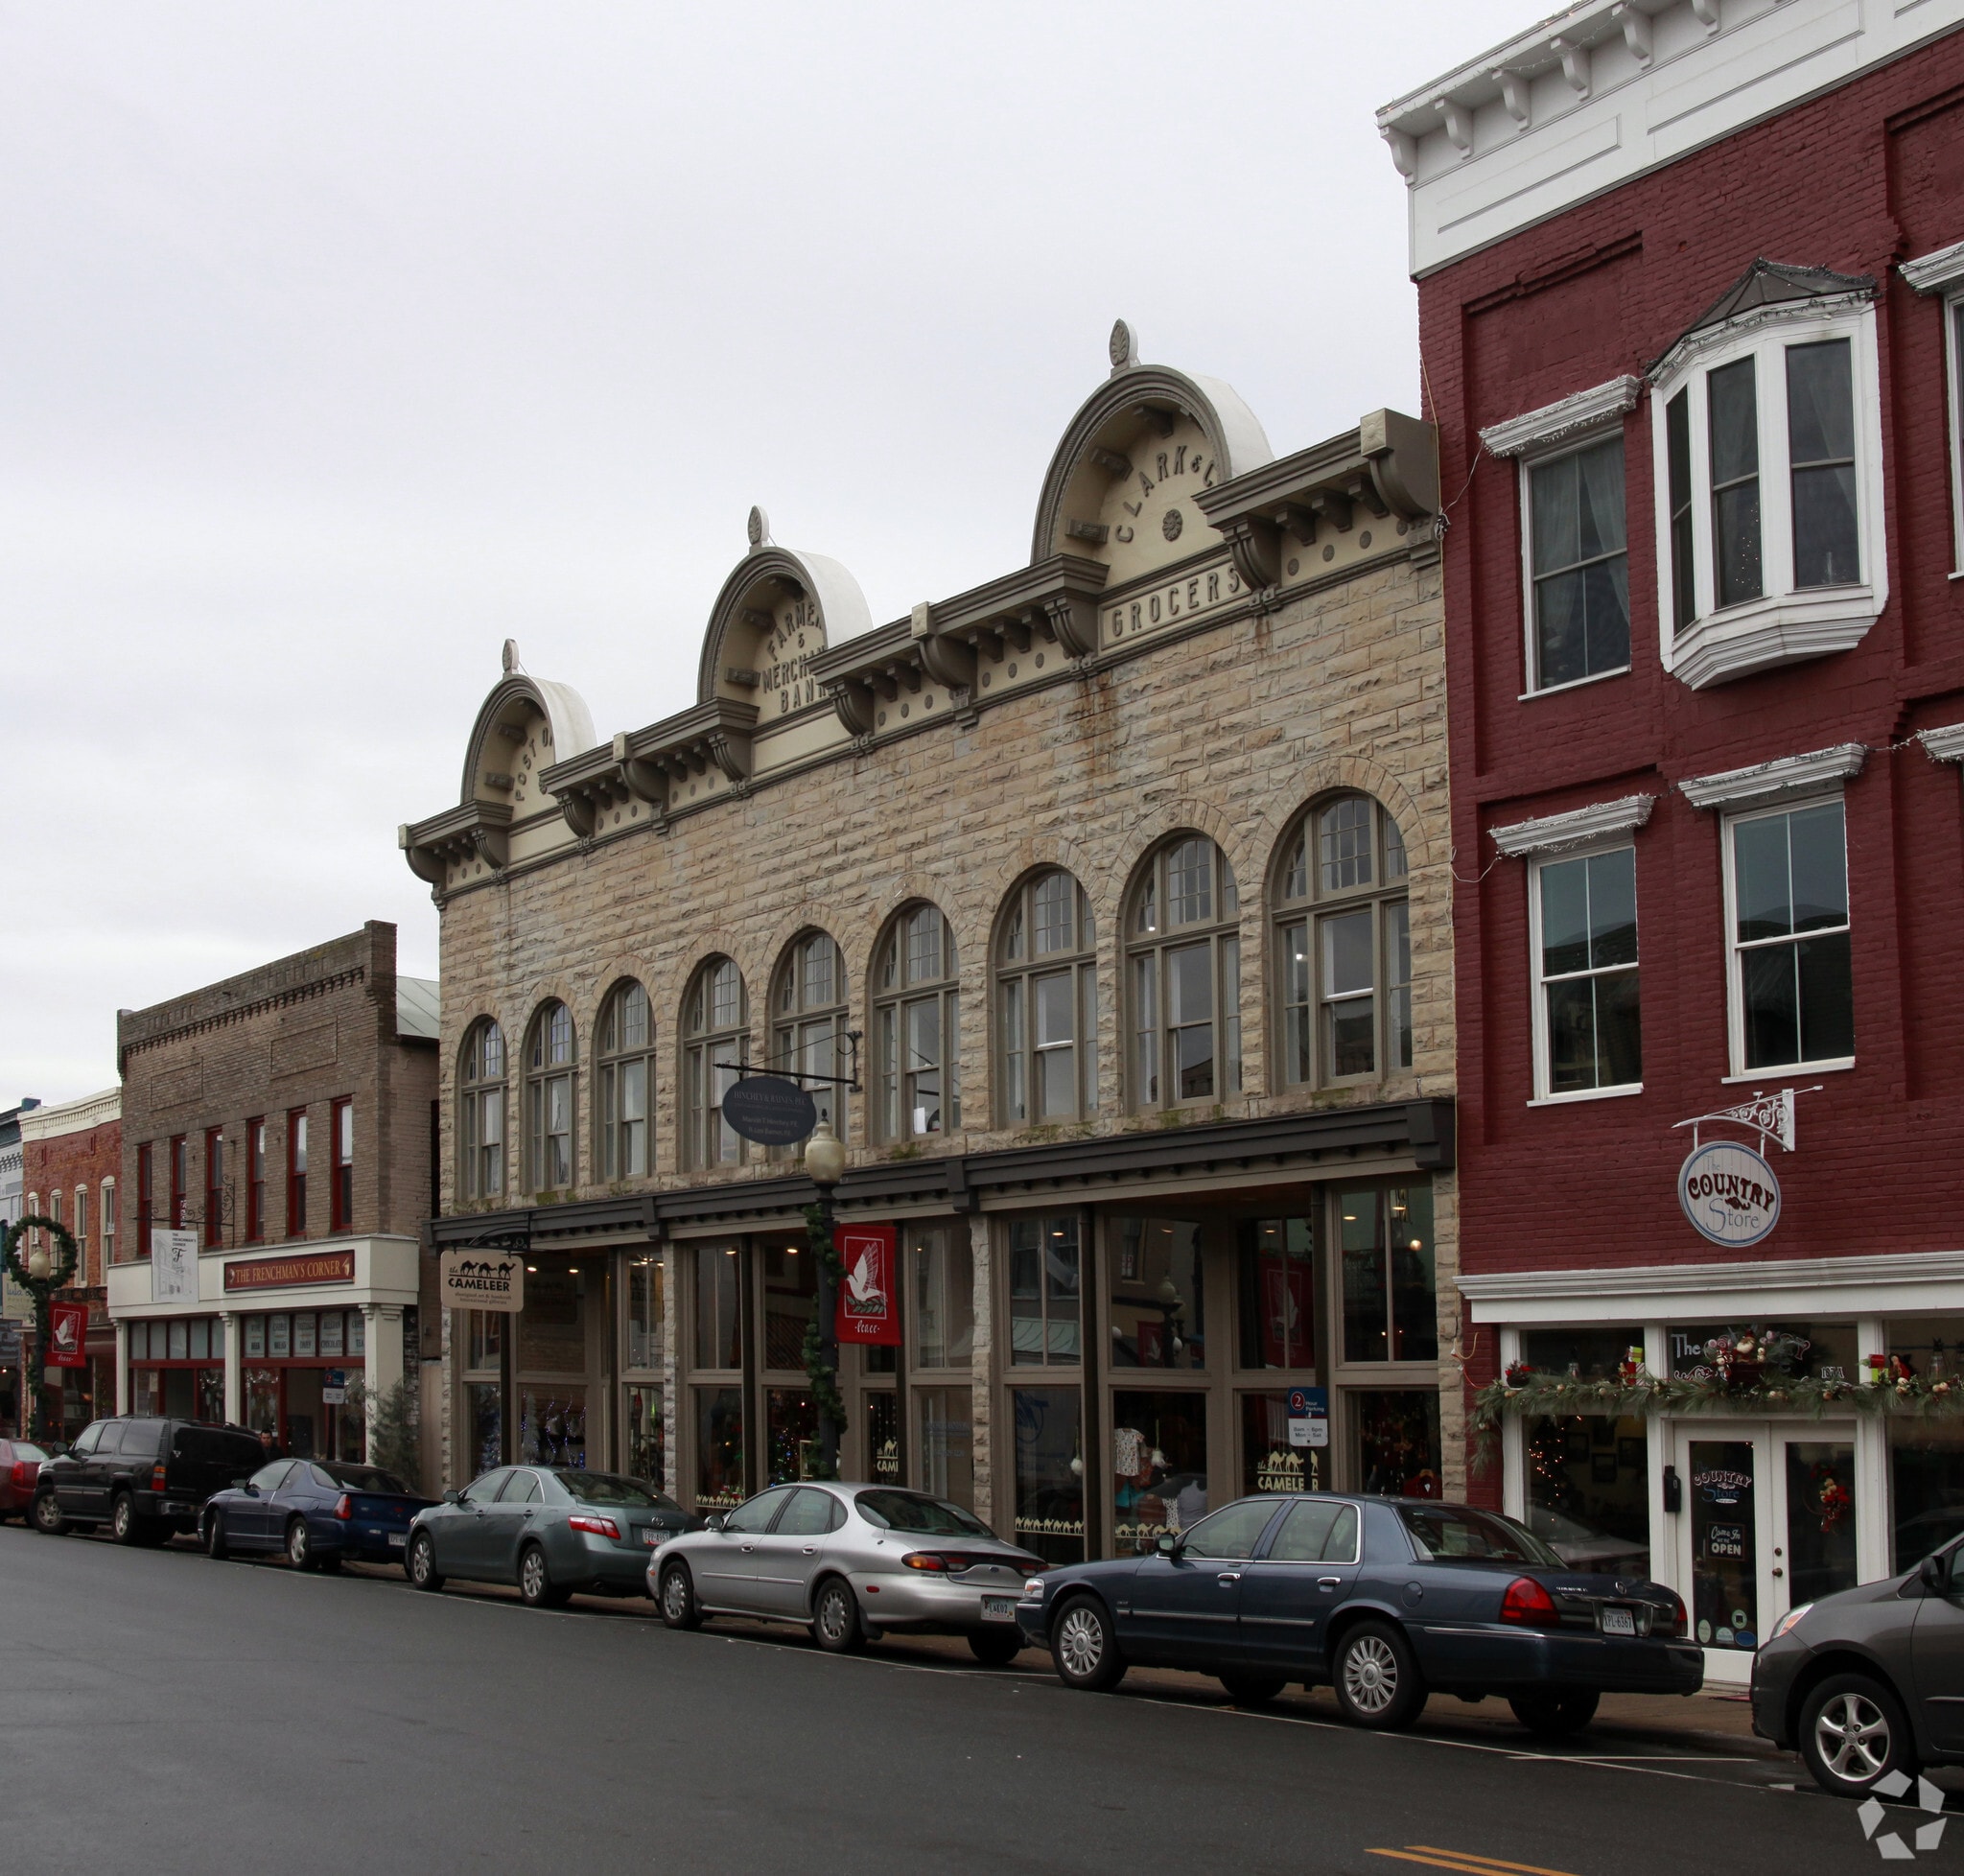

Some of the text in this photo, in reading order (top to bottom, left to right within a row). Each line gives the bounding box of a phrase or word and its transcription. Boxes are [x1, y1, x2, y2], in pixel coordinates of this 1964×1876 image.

[1115, 445, 1187, 543] CLARK
[1190, 455, 1203, 473] &
[1111, 566, 1241, 637] GROCERS
[515, 738, 537, 802] POST
[1705, 1155, 1720, 1171] The
[1688, 1173, 1775, 1212] COUNTRY
[1706, 1198, 1759, 1232] Store
[235, 1259, 340, 1283] THE FRENCHMAN'S CORNER
[448, 1278, 510, 1292] CAMELEER
[1671, 1333, 1701, 1358] The
[1295, 1395, 1301, 1407] 2
[1257, 1476, 1319, 1491] CAMELER
[1693, 1470, 1752, 1488] COUNTRY
[1701, 1484, 1740, 1503] Store
[1711, 1526, 1730, 1539] Come
[1711, 1542, 1742, 1556] OPEN
